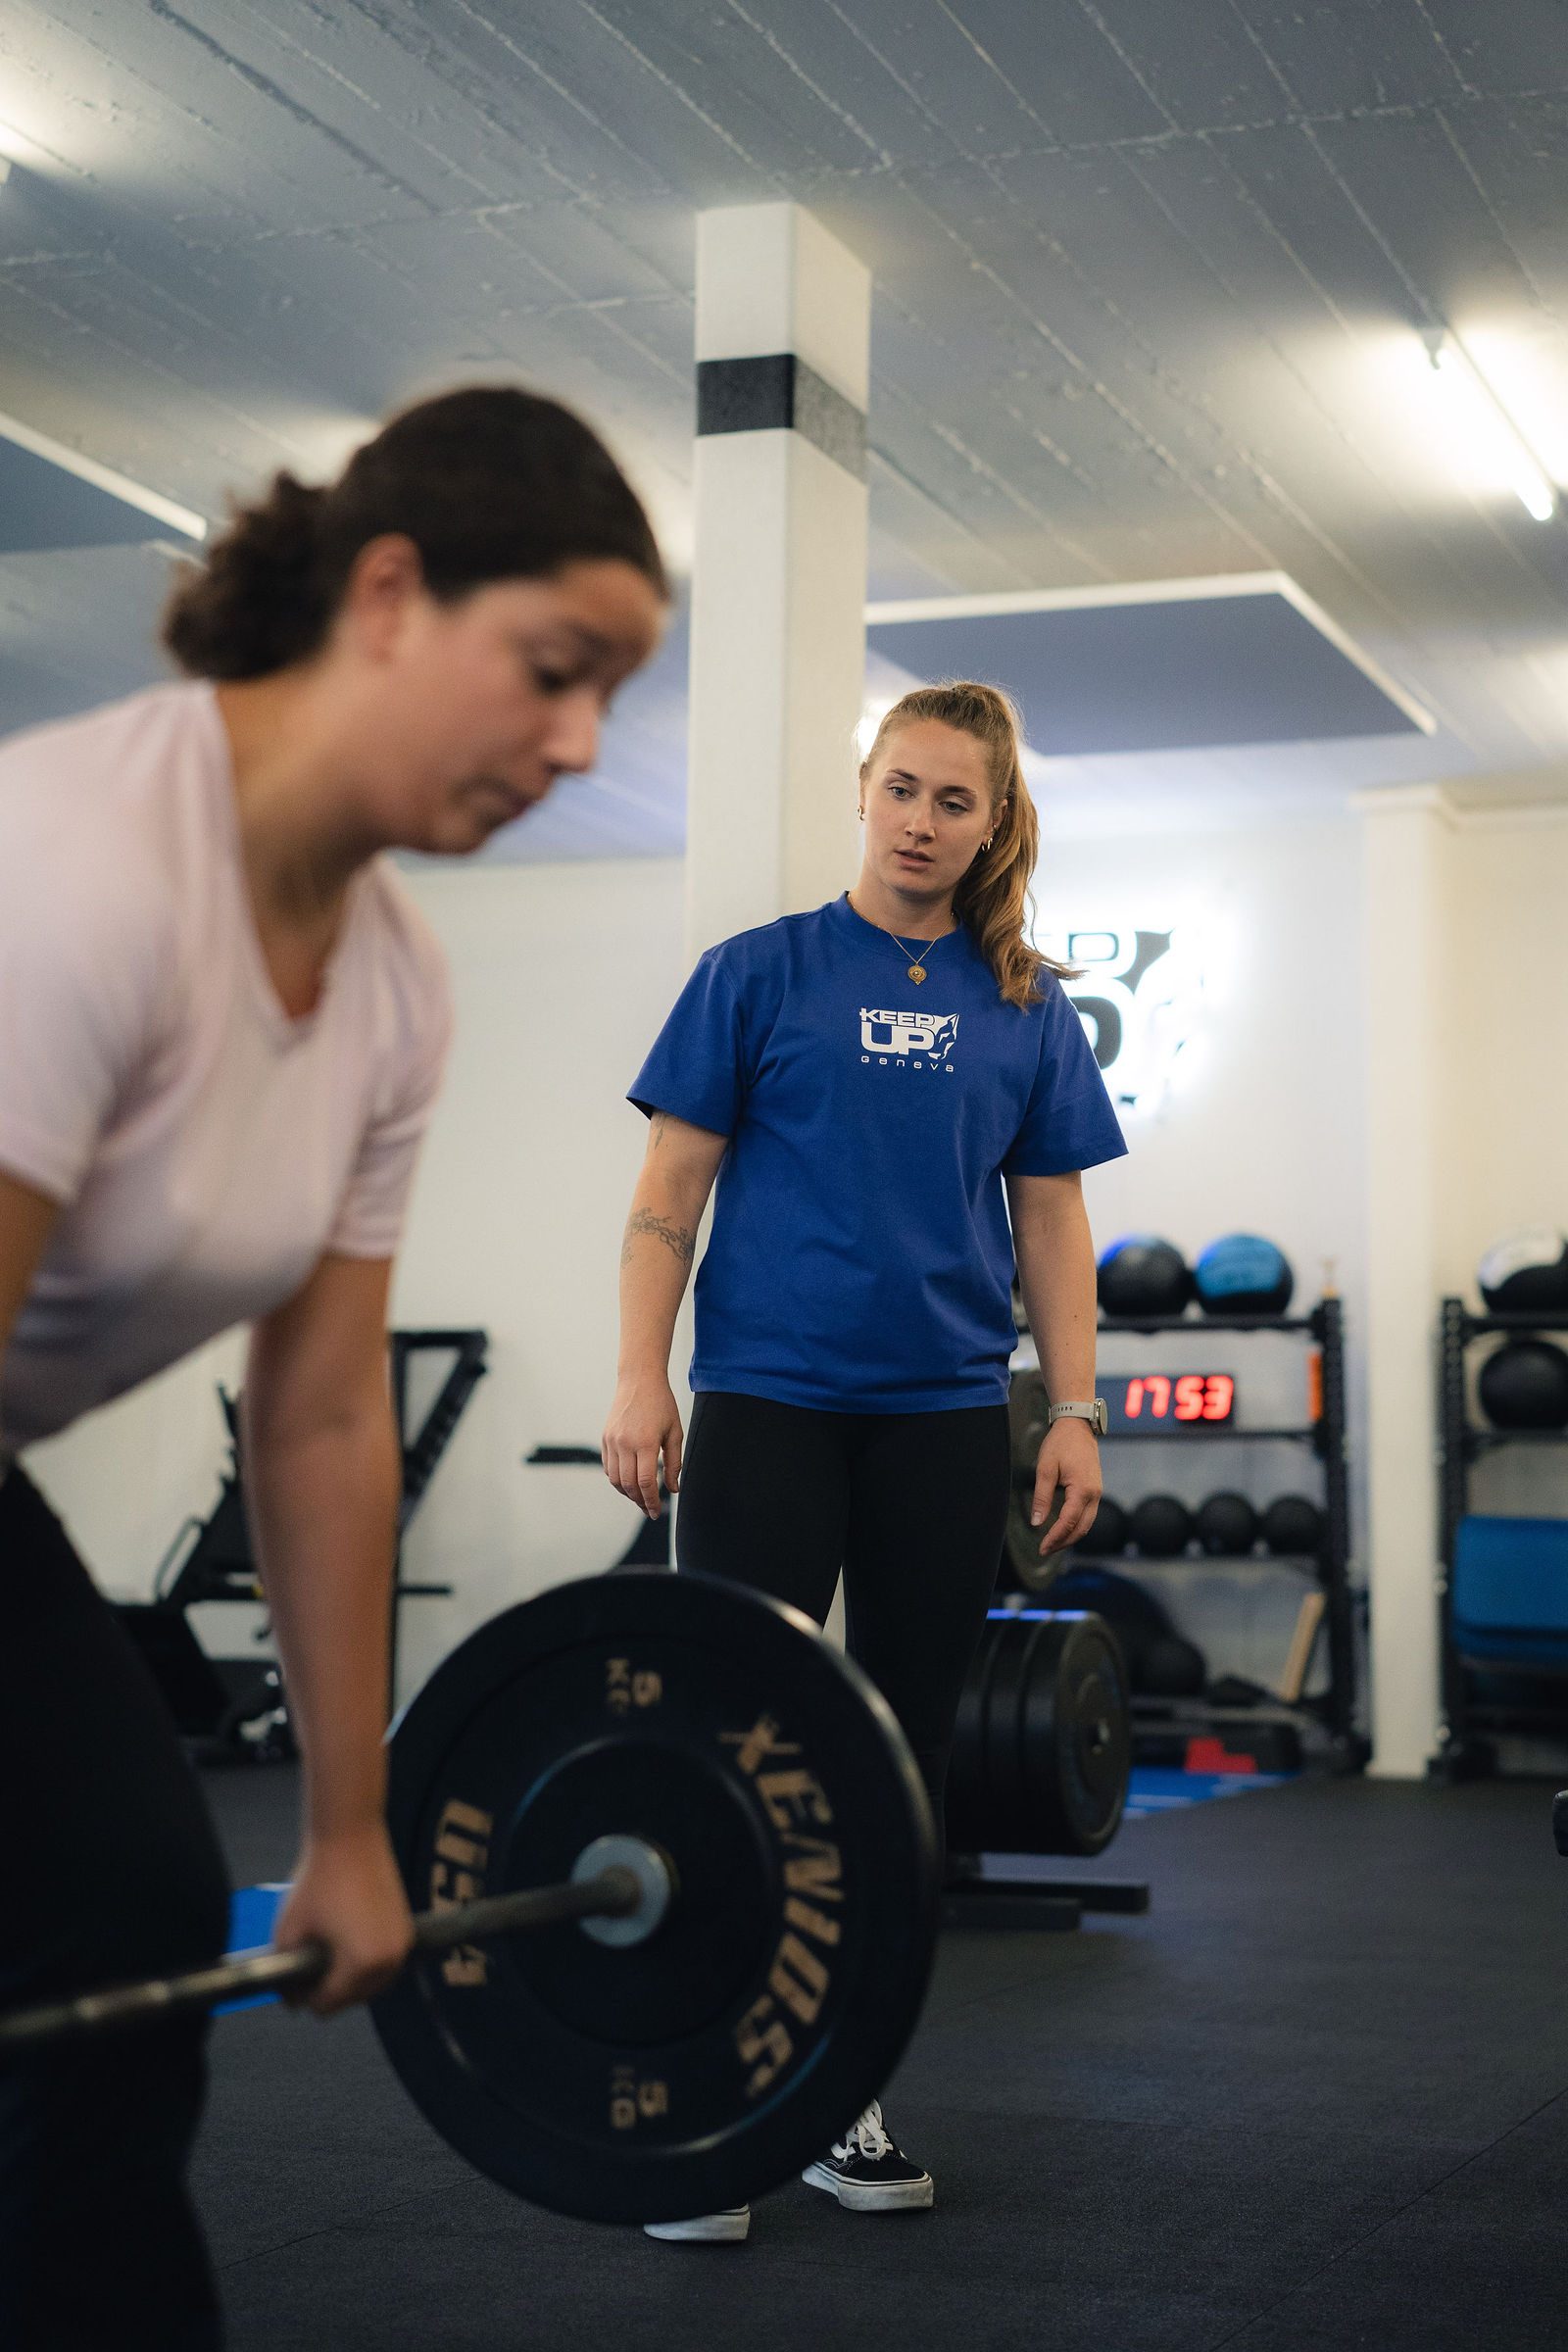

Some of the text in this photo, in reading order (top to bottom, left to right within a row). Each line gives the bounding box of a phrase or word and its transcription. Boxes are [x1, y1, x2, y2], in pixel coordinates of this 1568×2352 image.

[859, 1007, 935, 1027] KEEP
[860, 1021, 935, 1055] UP
[860, 1055, 955, 1073] Geneva
[716, 1709, 847, 2103] XENIOS
